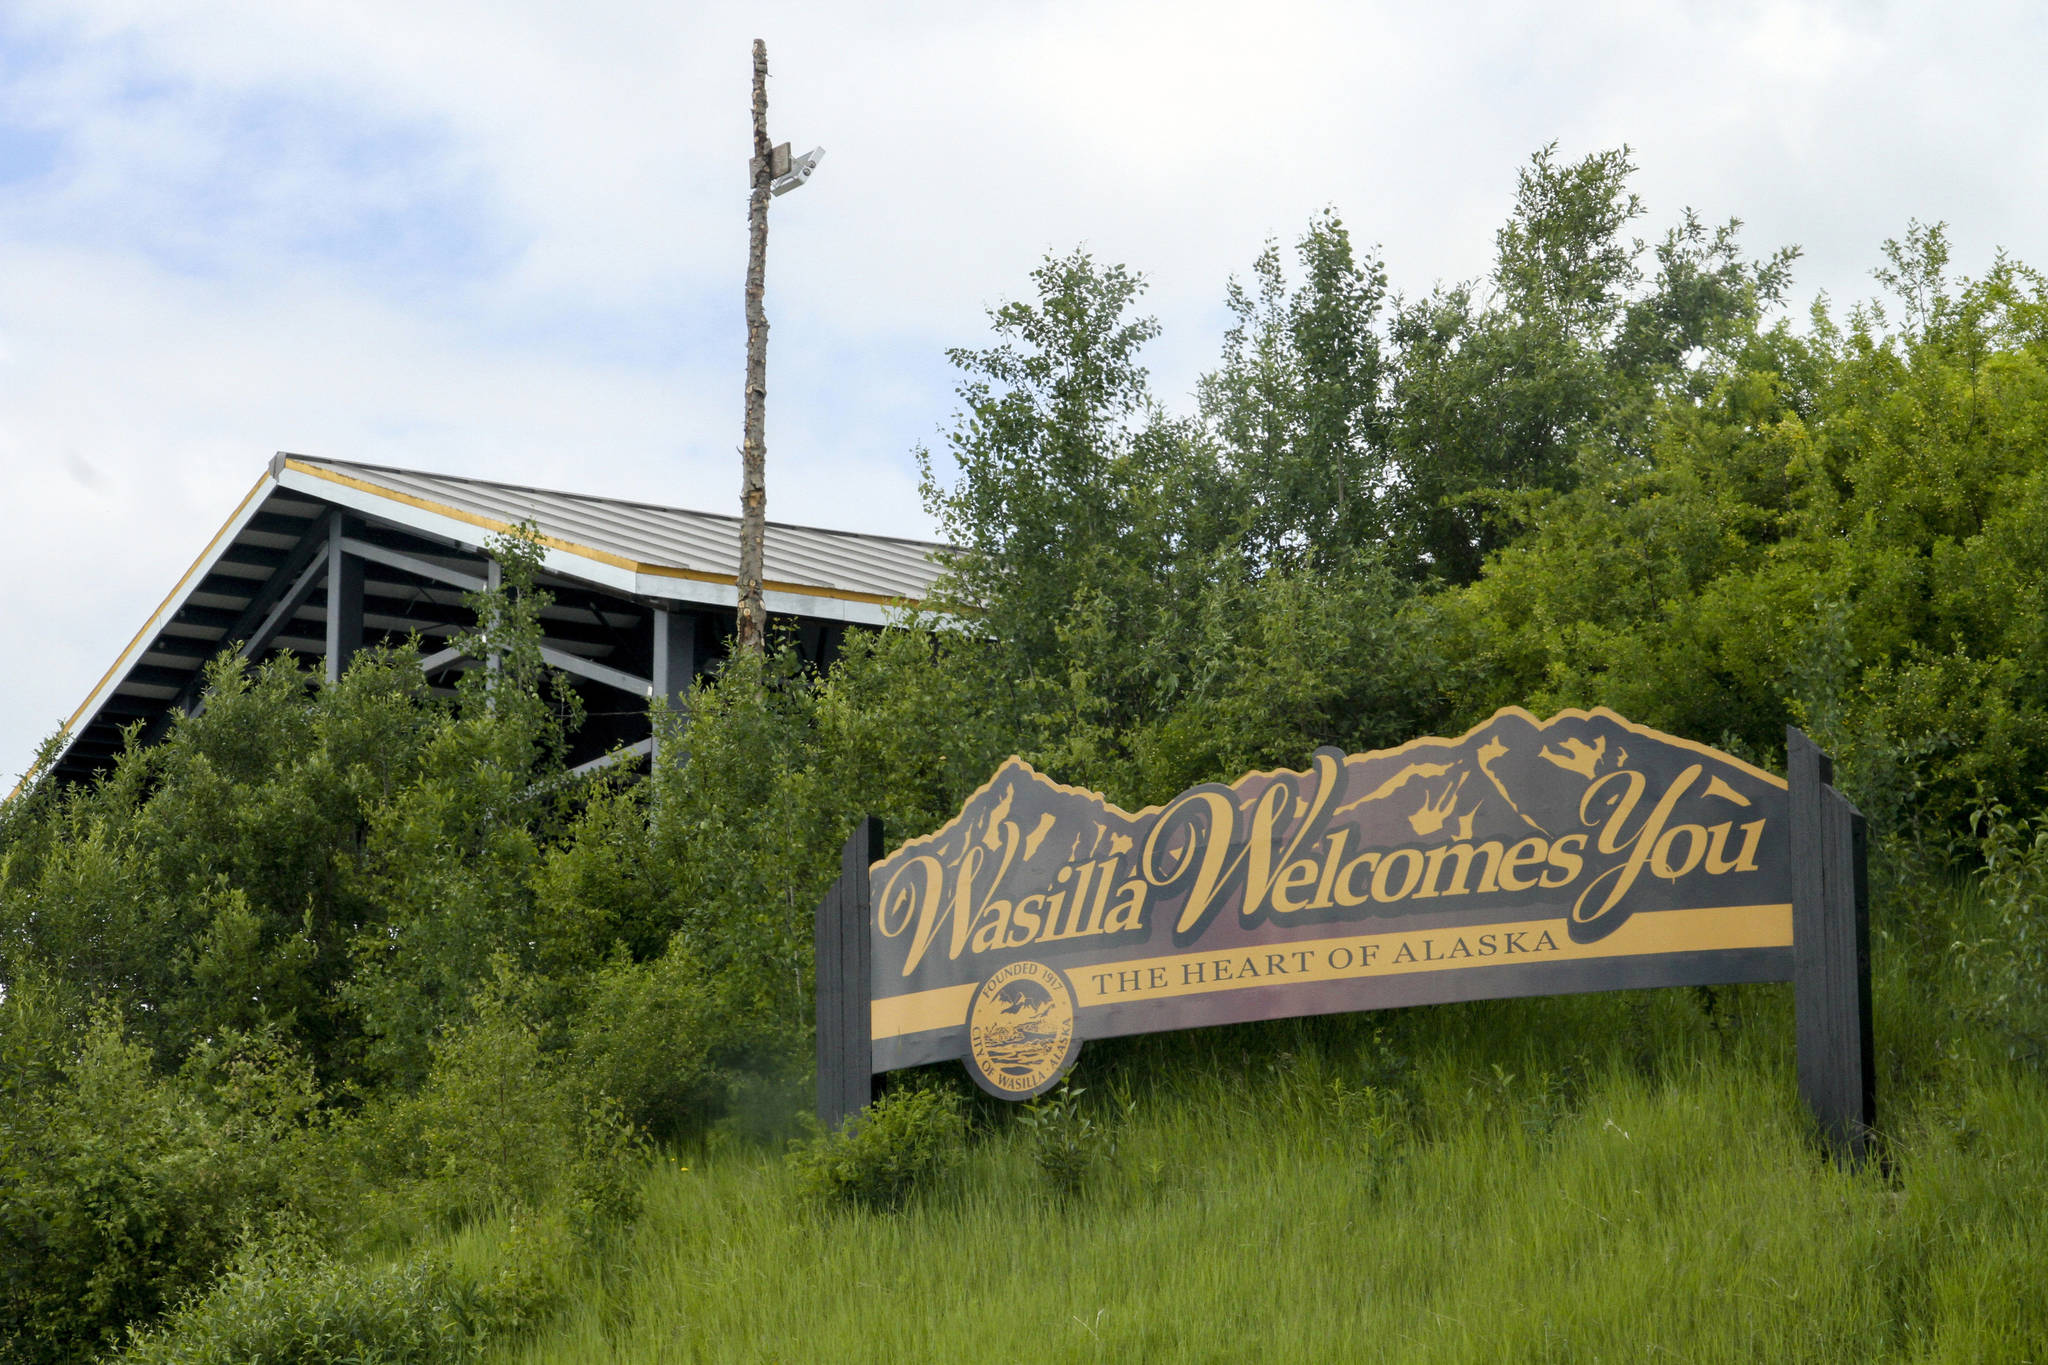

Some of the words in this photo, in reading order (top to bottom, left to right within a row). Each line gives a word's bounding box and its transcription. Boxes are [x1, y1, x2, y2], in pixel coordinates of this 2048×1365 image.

[878, 820, 1148, 977] Wasilla
[1142, 754, 1588, 934] Welcomes
[1573, 764, 1766, 923] You
[982, 963, 1038, 998] FOUNDED
[1042, 970, 1064, 991] 1917
[1092, 966, 1168, 995] THE
[1182, 950, 1316, 985] HEART
[1328, 945, 1381, 971] OF
[1393, 930, 1560, 965] ALASKA
[972, 1026, 984, 1058] CITY
[982, 1060, 996, 1077] OF
[997, 1072, 1046, 1090] WASILLA
[1049, 1017, 1071, 1068] ALASKA
